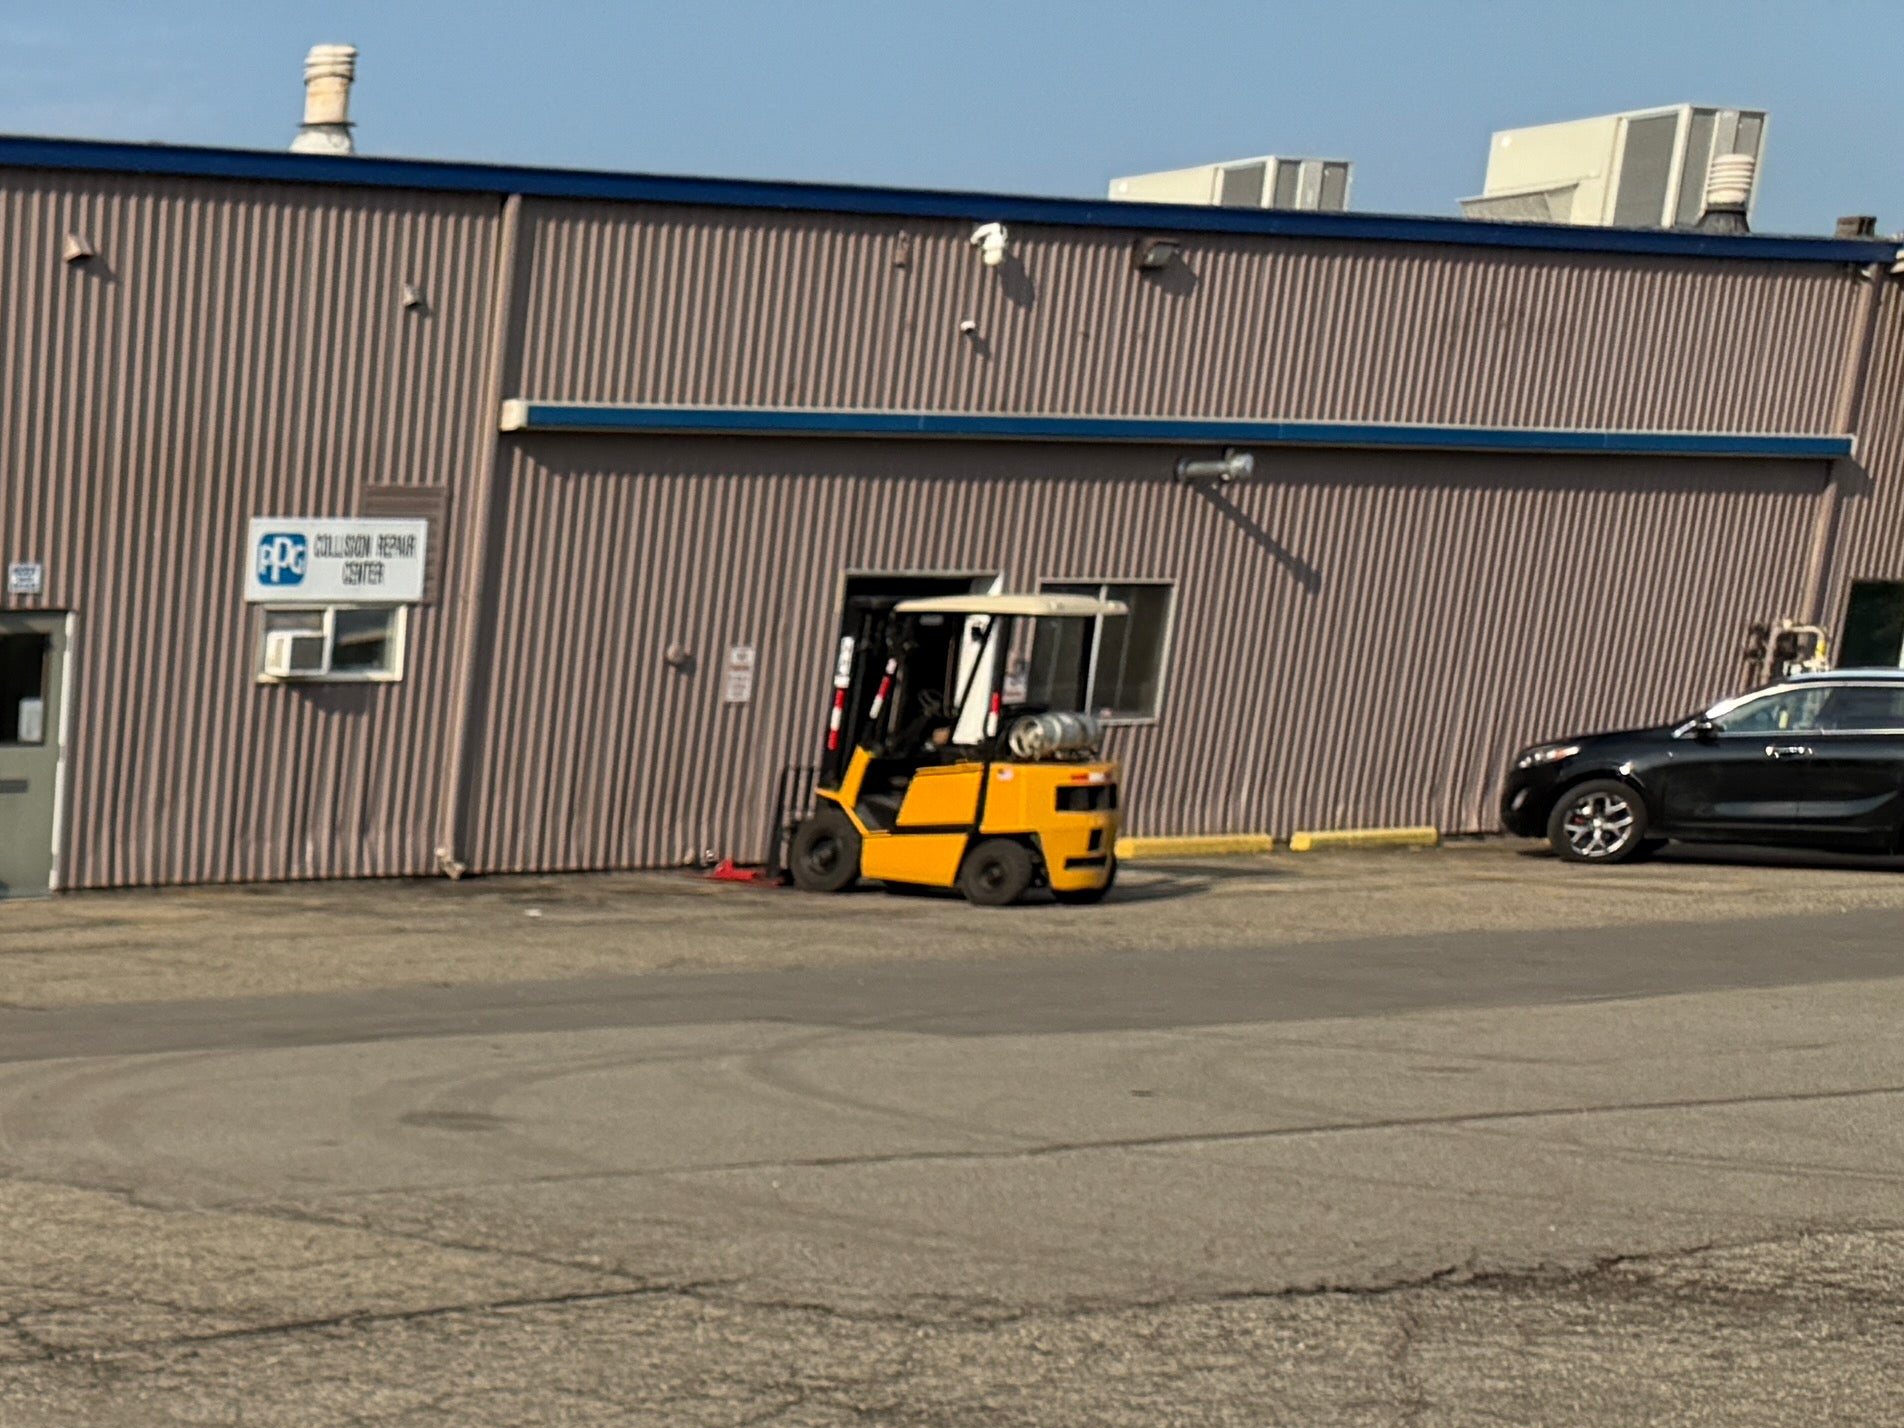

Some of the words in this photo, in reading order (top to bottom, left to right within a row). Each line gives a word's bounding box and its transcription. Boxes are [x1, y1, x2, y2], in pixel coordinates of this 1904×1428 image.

[314, 533, 373, 559] COLLISION
[376, 533, 417, 559] REPAIR
[258, 534, 307, 585] PPG
[342, 560, 385, 586] CENTER
